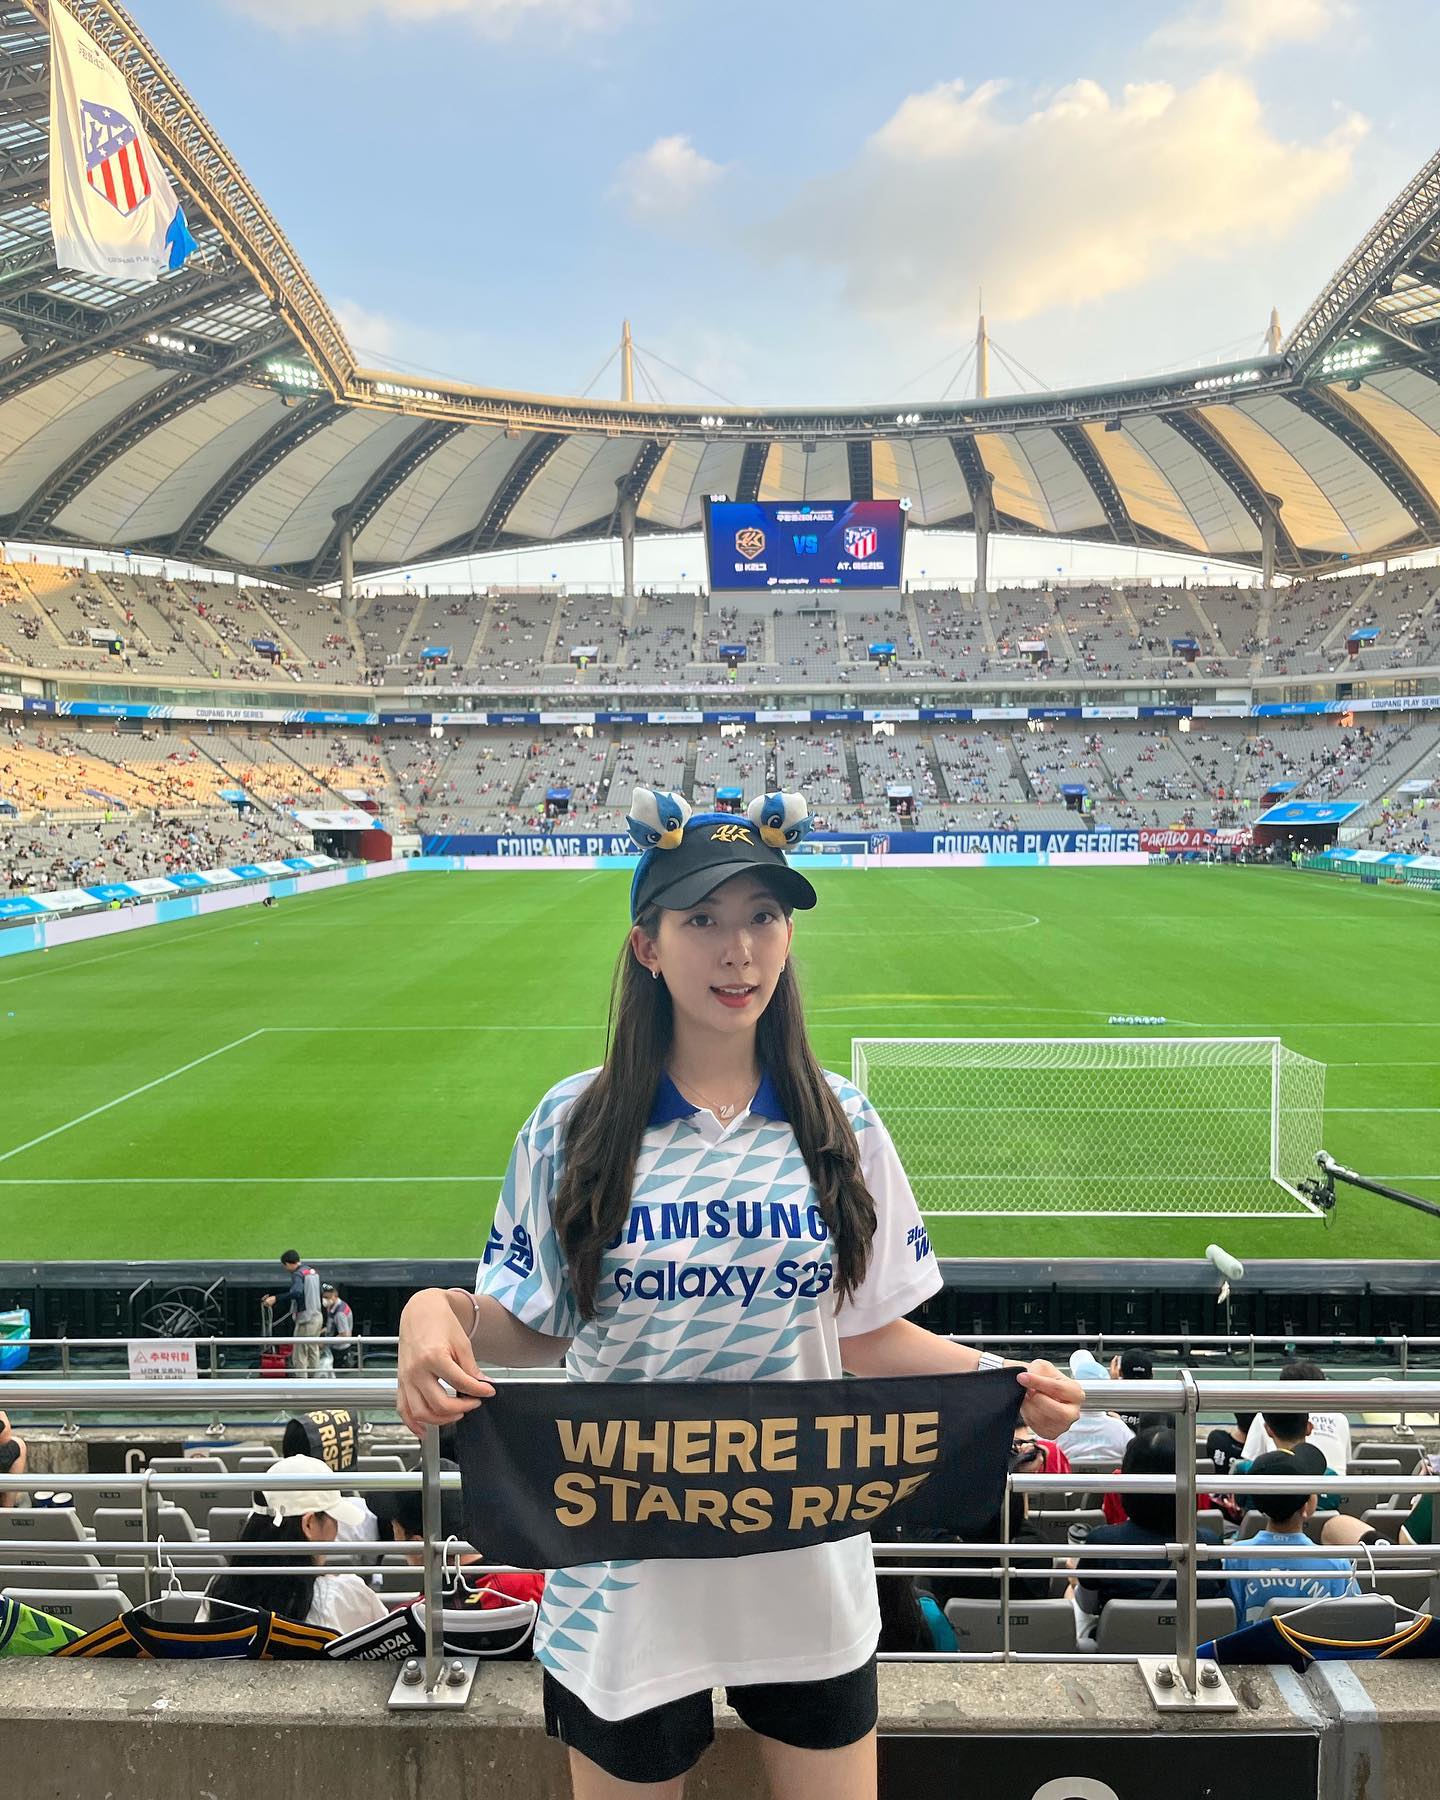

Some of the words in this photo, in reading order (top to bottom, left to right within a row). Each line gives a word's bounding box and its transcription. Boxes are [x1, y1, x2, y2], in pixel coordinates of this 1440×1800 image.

[792, 535, 818, 554] VS
[1372, 699, 1401, 708] COUPANG
[1403, 699, 1419, 707] PLAY
[1421, 698, 1440, 706] SERIE
[196, 709, 225, 717] COUPANG
[226, 710, 241, 718] PLAY
[496, 838, 581, 856] COUPANG
[587, 838, 631, 855] PLAY
[932, 835, 1018, 853] COUPANG
[1024, 835, 1070, 853] PLAY
[1075, 834, 1139, 853] SERIES
[1140, 831, 1189, 847] PARTIDO
[1191, 832, 1200, 845] A
[907, 1225, 927, 1246] Blu
[615, 1261, 766, 1307] Galaxy
[774, 1260, 833, 1299] S23
[150, 1351, 190, 1362] 추락위험
[555, 1416, 799, 1474] WHERE
[815, 1411, 940, 1470] THE
[553, 1472, 774, 1534] STARS
[1272, 1534, 1290, 1542] CITY
[350, 1632, 412, 1661] YUNDAI
